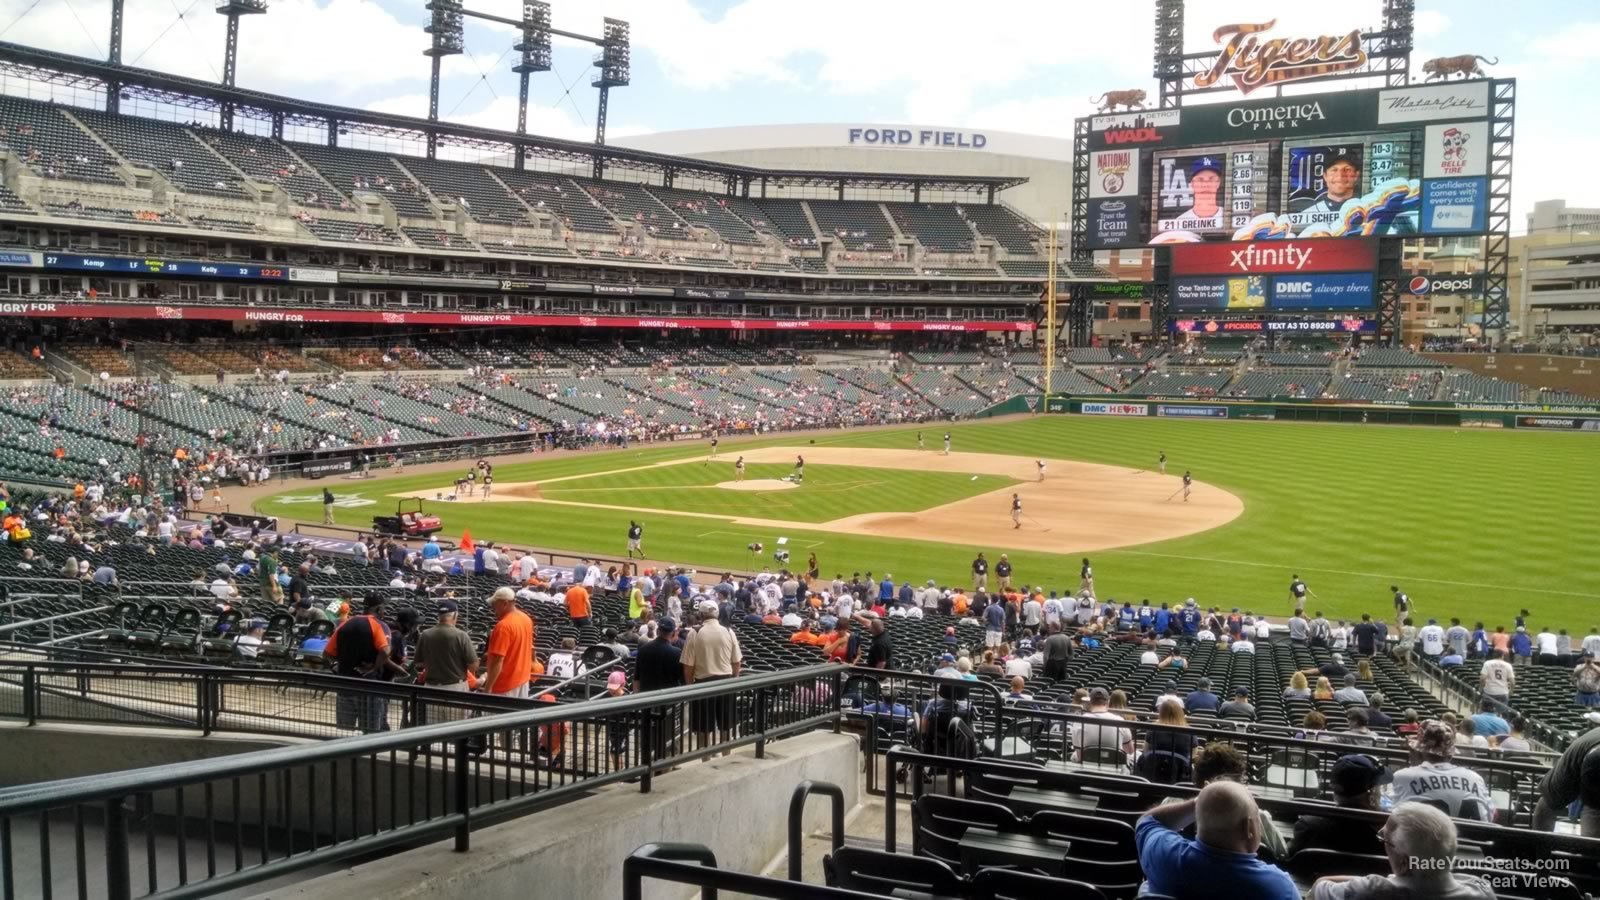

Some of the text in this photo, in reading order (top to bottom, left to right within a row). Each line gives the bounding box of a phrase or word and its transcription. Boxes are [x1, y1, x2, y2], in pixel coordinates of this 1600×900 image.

[1194, 18, 1367, 94] Tigers
[1253, 120, 1298, 130] PARK
[848, 128, 986, 148] FORD FIELD
[1104, 128, 1163, 144] WADL
[1372, 144, 1391, 153] 10-3
[1098, 152, 1130, 168] NATIONAL
[1234, 153, 1252, 163] 11-4
[1372, 161, 1392, 170] 3.47
[1234, 170, 1250, 178] 2.66
[1233, 185, 1251, 194] 1.18
[1234, 201, 1250, 210] 119
[1430, 197, 1452, 205] every
[1236, 218, 1246, 226] 22
[1292, 215, 1303, 223] 37
[1097, 219, 1128, 230] Team
[1164, 219, 1216, 230] 21 GREINKE
[1230, 243, 1312, 271] xfinity
[1276, 282, 1312, 293] DMC
[1315, 284, 1344, 295] always
[1432, 278, 1472, 292] pepsi
[0, 303, 56, 312] GRY FOR
[246, 312, 284, 320] HUNGRY
[553, 666, 562, 676] 6
[1495, 669, 1502, 680] 6
[1410, 775, 1479, 796] CABRERA
